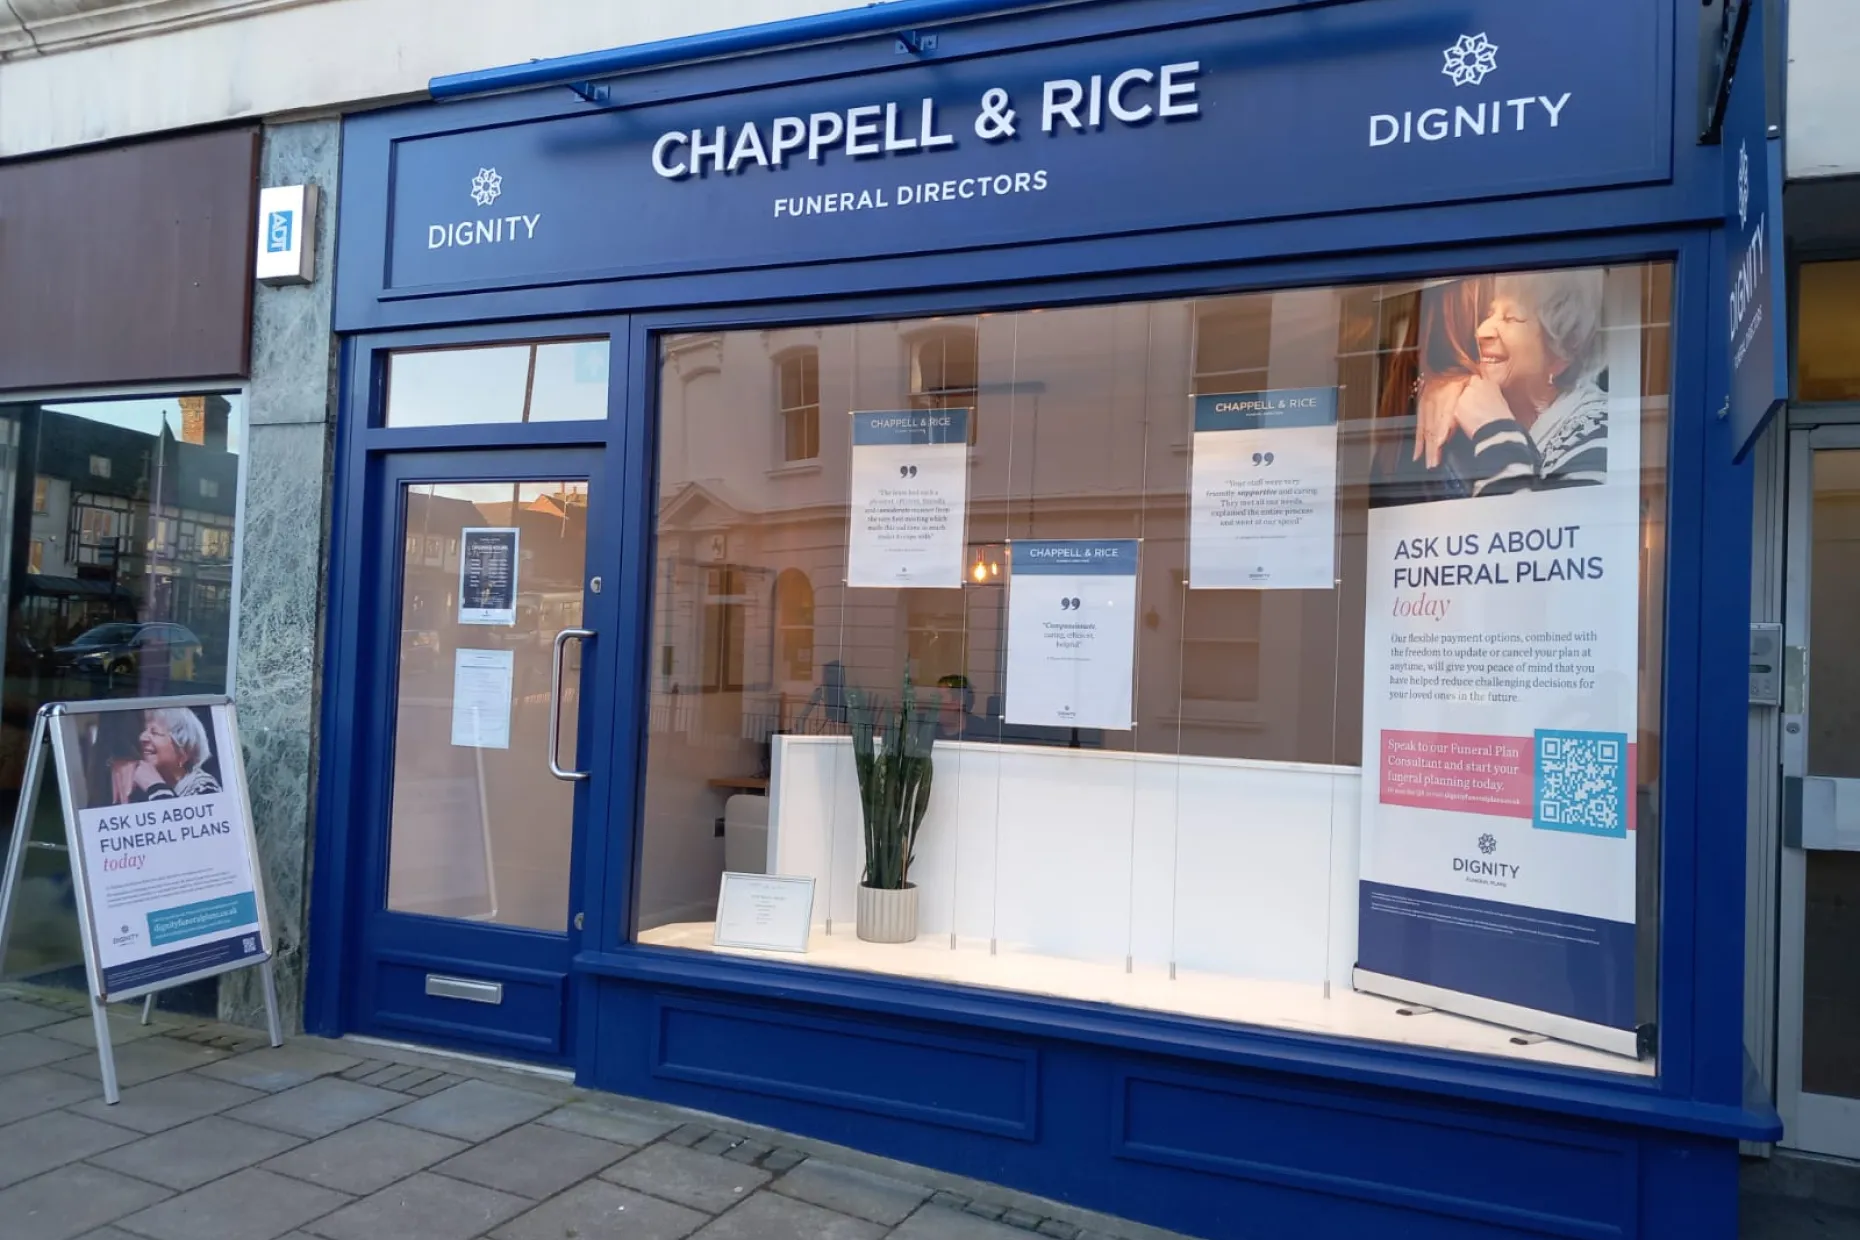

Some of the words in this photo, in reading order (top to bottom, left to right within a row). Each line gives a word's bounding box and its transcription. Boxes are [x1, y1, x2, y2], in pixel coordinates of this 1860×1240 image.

[651, 98, 953, 179] CHAPPELL
[974, 87, 1016, 140] &
[1041, 61, 1201, 131] RICE
[1369, 92, 1572, 147] DIGNITY
[773, 188, 890, 218] FUNERAL
[897, 170, 1049, 206] DIRECTORS
[270, 212, 288, 251] ADT
[428, 213, 541, 249] DIGNITY
[1730, 212, 1765, 342] DIGNITY
[1215, 400, 1275, 412] CHAPPELL
[1278, 400, 1286, 409] &
[1289, 397, 1317, 408] RICE
[870, 418, 918, 428] CHAPPELL
[929, 416, 951, 427] RICE
[1029, 548, 1082, 558] CHAPPELL
[1084, 548, 1092, 558] &
[1094, 547, 1119, 558] RICE
[1394, 537, 1440, 561] ASK
[1446, 534, 1480, 556] US
[1487, 525, 1581, 555] ABOUT
[1394, 563, 1509, 589] FUNERAL
[1516, 556, 1604, 584] PLANS
[1392, 592, 1450, 622] today
[1390, 633, 1407, 644] Our
[1408, 632, 1439, 643] flexible
[1440, 633, 1483, 645] payment
[1484, 632, 1523, 645] options,
[1525, 631, 1573, 643] combined
[1574, 630, 1598, 642] with
[1390, 647, 1404, 657] the
[1405, 647, 1441, 657] freedom
[1443, 647, 1453, 657] to
[1454, 647, 1488, 660] update
[1489, 649, 1501, 657] or
[1502, 646, 1533, 658] cancel
[1535, 649, 1558, 660] your
[1559, 646, 1580, 660] plan
[1582, 648, 1592, 658] at
[1428, 660, 1444, 671] will
[1445, 662, 1465, 673] give
[1466, 663, 1485, 674] you
[1487, 664, 1514, 674] peace
[1515, 662, 1527, 673] of
[1528, 661, 1553, 673] mind
[1555, 662, 1575, 673] that
[1576, 664, 1595, 675] you
[1389, 675, 1408, 685] have
[1409, 675, 1439, 688] helped
[1440, 676, 1474, 687] reduce
[1475, 676, 1532, 690] challenging
[1532, 676, 1577, 689] decisions
[1579, 678, 1596, 689] for
[1389, 691, 1408, 701] your
[1409, 688, 1433, 700] loved
[1434, 691, 1456, 701] ones
[1458, 690, 1467, 701] in
[1469, 690, 1485, 702] the
[1387, 738, 1417, 753] Speak
[1418, 741, 1428, 752] to
[1430, 744, 1448, 754] our
[1451, 743, 1492, 757] Funeral
[1495, 745, 1519, 758] Plan
[1387, 755, 1443, 768] Consultant
[1444, 759, 1464, 771] and
[1465, 760, 1493, 773] start
[1494, 764, 1520, 777] your
[1387, 770, 1422, 784] funeral
[1424, 773, 1471, 790] planning
[1472, 777, 1505, 793] today.
[97, 814, 131, 833] ASK
[135, 811, 157, 827] US
[162, 803, 215, 824] ABOUT
[100, 828, 178, 853] FUNERAL
[180, 820, 231, 841] PLANS
[103, 853, 146, 871] today
[1453, 857, 1520, 879] DIGNITY
